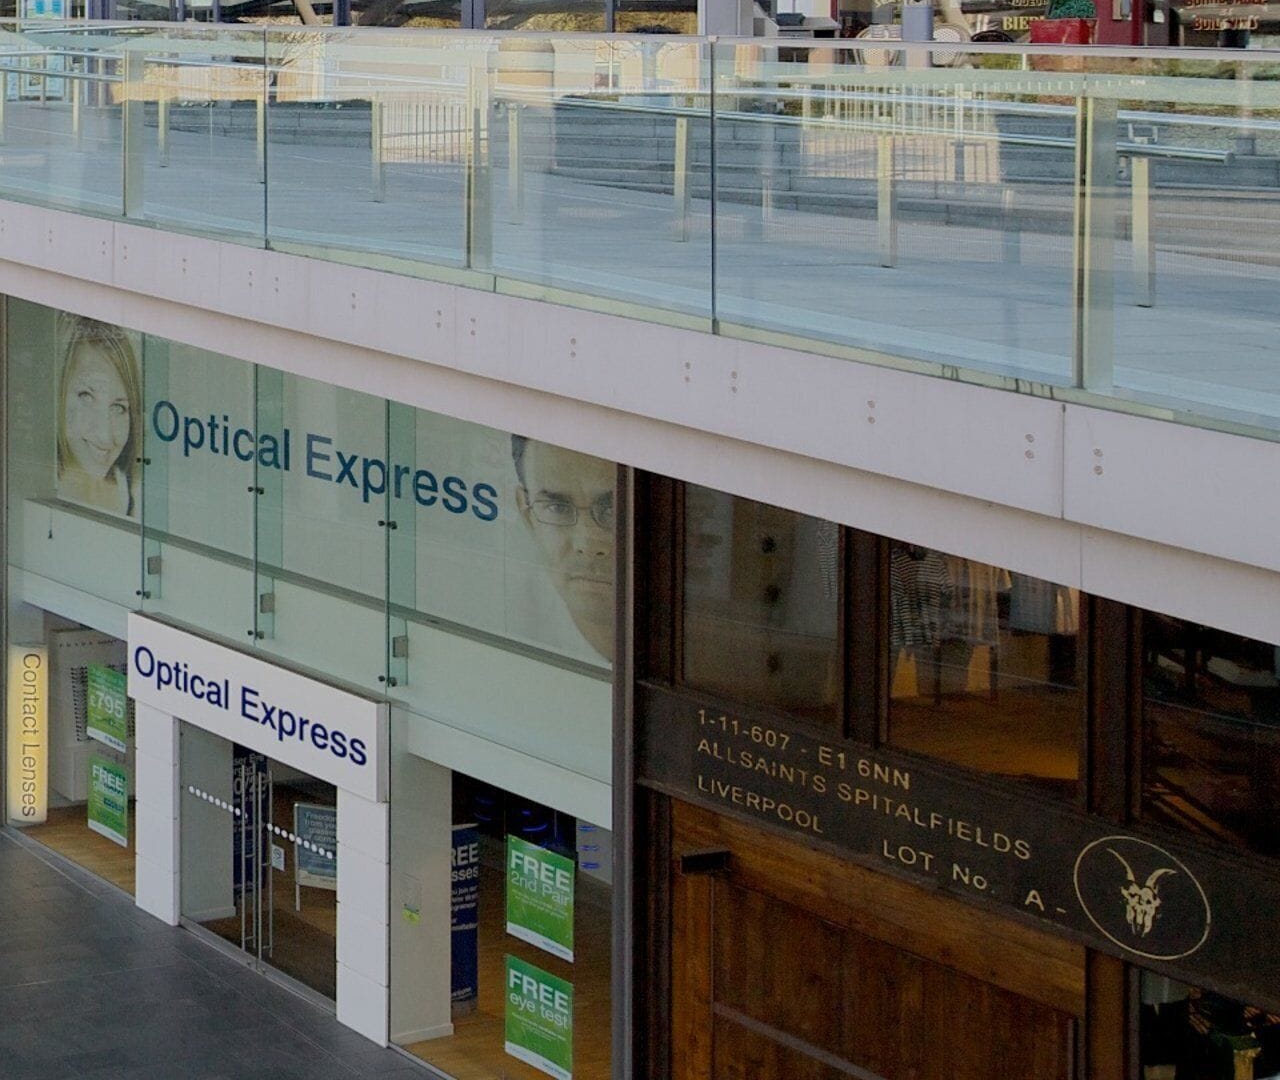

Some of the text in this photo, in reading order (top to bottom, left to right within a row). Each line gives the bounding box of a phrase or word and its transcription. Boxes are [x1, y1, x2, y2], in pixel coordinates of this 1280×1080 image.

[152, 400, 500, 522] Optical Express
[21, 653, 41, 817] Contact Lenses
[134, 646, 367, 766] Optical Express
[698, 709, 791, 752] 1-11-607
[818, 745, 847, 770] E1
[857, 758, 912, 791] 6NN
[697, 738, 1032, 862] ALLSAINTS SPITALFIELDS
[697, 774, 824, 835] LIVERPOOL
[510, 849, 571, 893] FREE
[511, 870, 538, 893] 2nd
[542, 883, 571, 908] Pair
[509, 967, 570, 1015] FREE
[509, 992, 569, 1031] eye test
